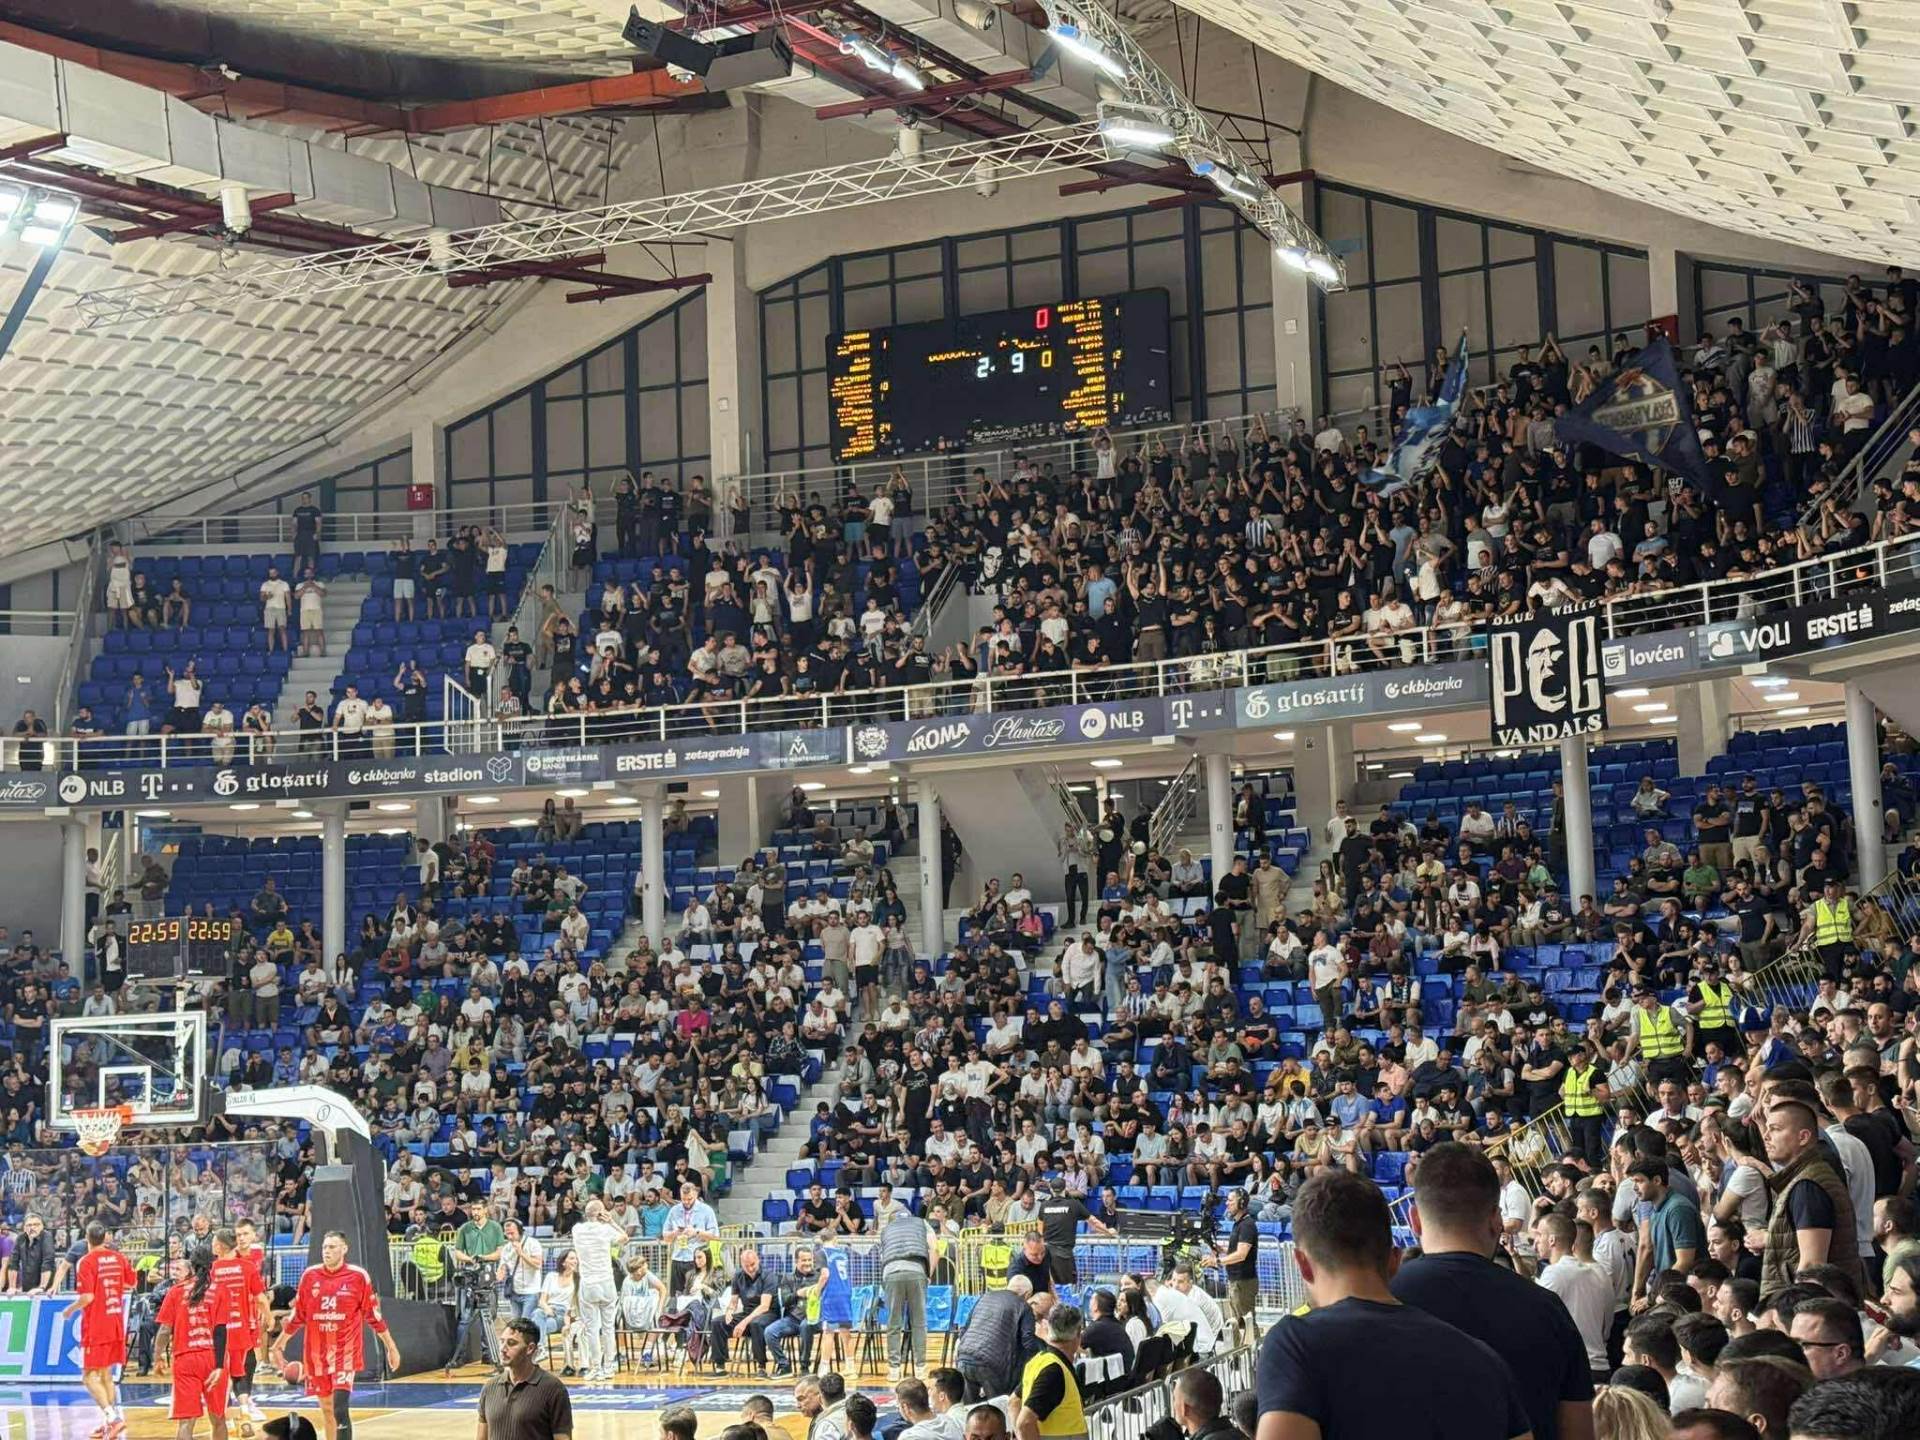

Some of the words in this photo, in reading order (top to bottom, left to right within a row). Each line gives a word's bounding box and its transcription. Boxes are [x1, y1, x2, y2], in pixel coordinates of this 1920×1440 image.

[1036, 308, 1049, 329] 0
[1041, 350, 1052, 368] 0
[1807, 610, 1858, 640] ERSTE
[1740, 620, 1790, 652] VOLI
[1630, 644, 1685, 667] lovćen
[1277, 682, 1364, 713] glosarij
[1110, 711, 1144, 729] NLB
[1497, 713, 1603, 746] VANDALS
[906, 722, 971, 752] AROMA
[617, 753, 663, 772] ERSTE
[684, 746, 750, 761] zetagradnja
[246, 769, 329, 792] glosarij
[424, 767, 483, 783] stadion
[90, 780, 125, 796] NLB
[129, 921, 180, 944] 22:59
[188, 921, 231, 941] 22:59
[320, 1296, 337, 1310] 24
[336, 1371, 353, 1384] 24
